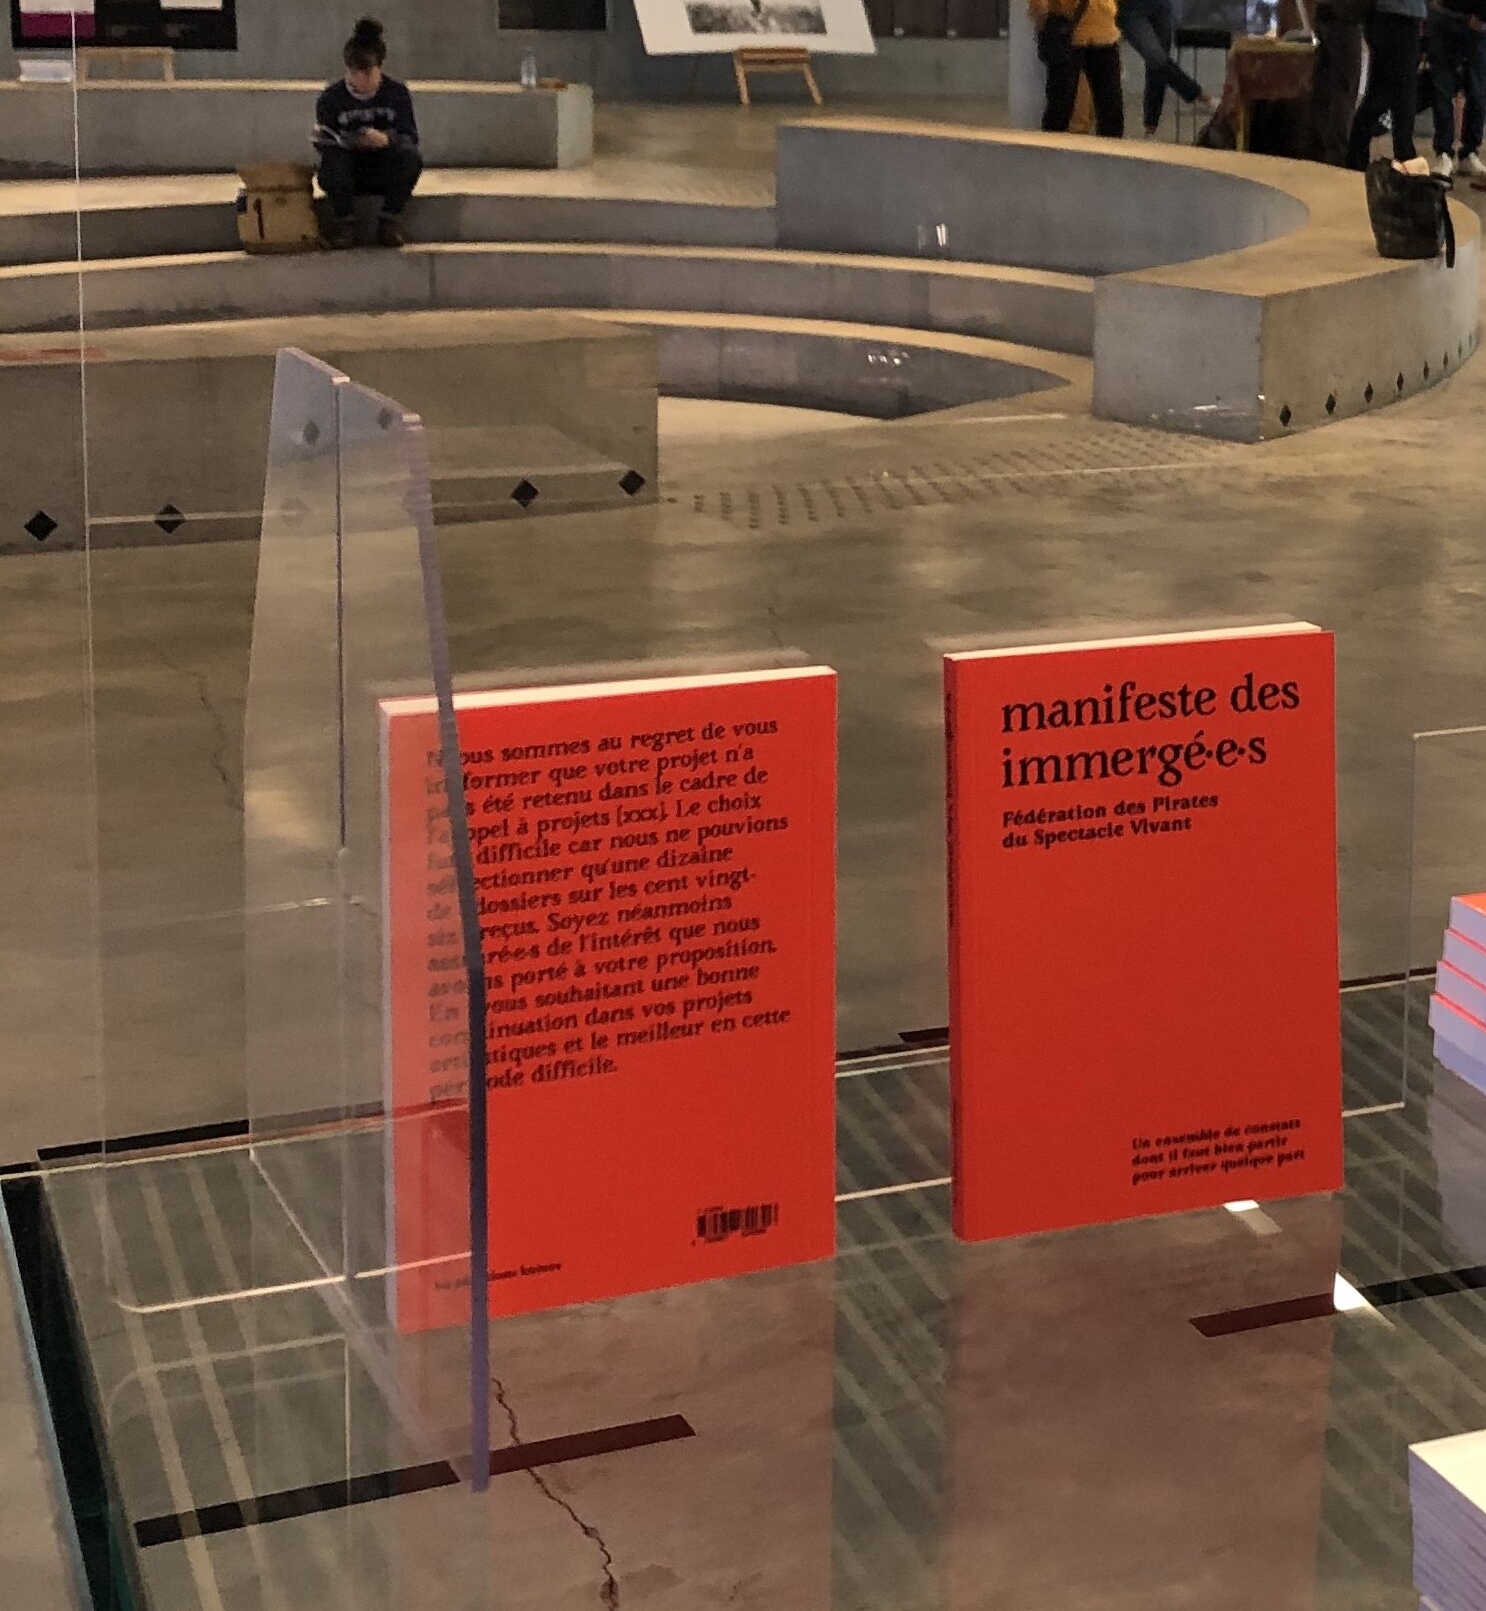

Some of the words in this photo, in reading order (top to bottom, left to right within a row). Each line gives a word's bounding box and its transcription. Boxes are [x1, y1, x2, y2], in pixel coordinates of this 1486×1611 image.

[1001, 681, 1217, 733] manifeste
[1230, 671, 1300, 714] des
[501, 739, 590, 761] sommes
[598, 736, 622, 752] au
[631, 727, 695, 752] regret
[701, 722, 726, 740] de
[732, 720, 779, 736] vous
[549, 764, 588, 788] que
[594, 758, 650, 777] votre
[657, 748, 718, 777] projet
[482, 792, 514, 814] été
[522, 788, 592, 810] retenu
[598, 781, 649, 802] dans
[655, 777, 673, 795] le
[679, 770, 738, 792] cadre
[743, 766, 768, 785] de
[516, 817, 529, 835] à
[537, 811, 610, 840] projets
[675, 799, 701, 818] Le
[707, 792, 762, 814] choix
[1003, 803, 1107, 828] Fédération
[1113, 799, 1146, 818] des
[1152, 793, 1219, 814] Pirates
[476, 839, 561, 865] difficile
[568, 838, 603, 854] car
[610, 831, 658, 849] nous
[665, 827, 691, 843] ne
[697, 815, 790, 846] pouvions
[1002, 831, 1028, 849] du
[1033, 822, 1124, 851] Spectacle
[1130, 816, 1192, 835] Vivant
[581, 856, 650, 884] qu'une
[656, 845, 733, 868] dizaine
[568, 885, 603, 904] sur
[609, 880, 637, 900] les
[644, 875, 689, 895] cent
[695, 867, 757, 890] vingt-
[547, 910, 609, 934] Soyez
[617, 894, 733, 923] néanmoins
[547, 936, 573, 956] de
[579, 925, 661, 952] l'intérêt
[668, 922, 706, 946] que
[713, 916, 761, 936] nous
[510, 962, 568, 993] porté
[573, 960, 587, 978] à
[594, 954, 649, 973] votre
[656, 938, 778, 973] proposition.
[535, 979, 645, 1008] souhaitant
[651, 974, 690, 992] une
[697, 965, 760, 986] bonne
[585, 1006, 634, 1026] dans
[642, 1001, 675, 1017] vos
[683, 990, 753, 1019] projets
[564, 1036, 584, 1053] et
[590, 1030, 608, 1050] le
[616, 1021, 704, 1046] meilleur
[711, 1017, 736, 1033] en
[742, 1009, 790, 1028] cette
[531, 1056, 617, 1084] difficile.
[1224, 1125, 1241, 1137] de
